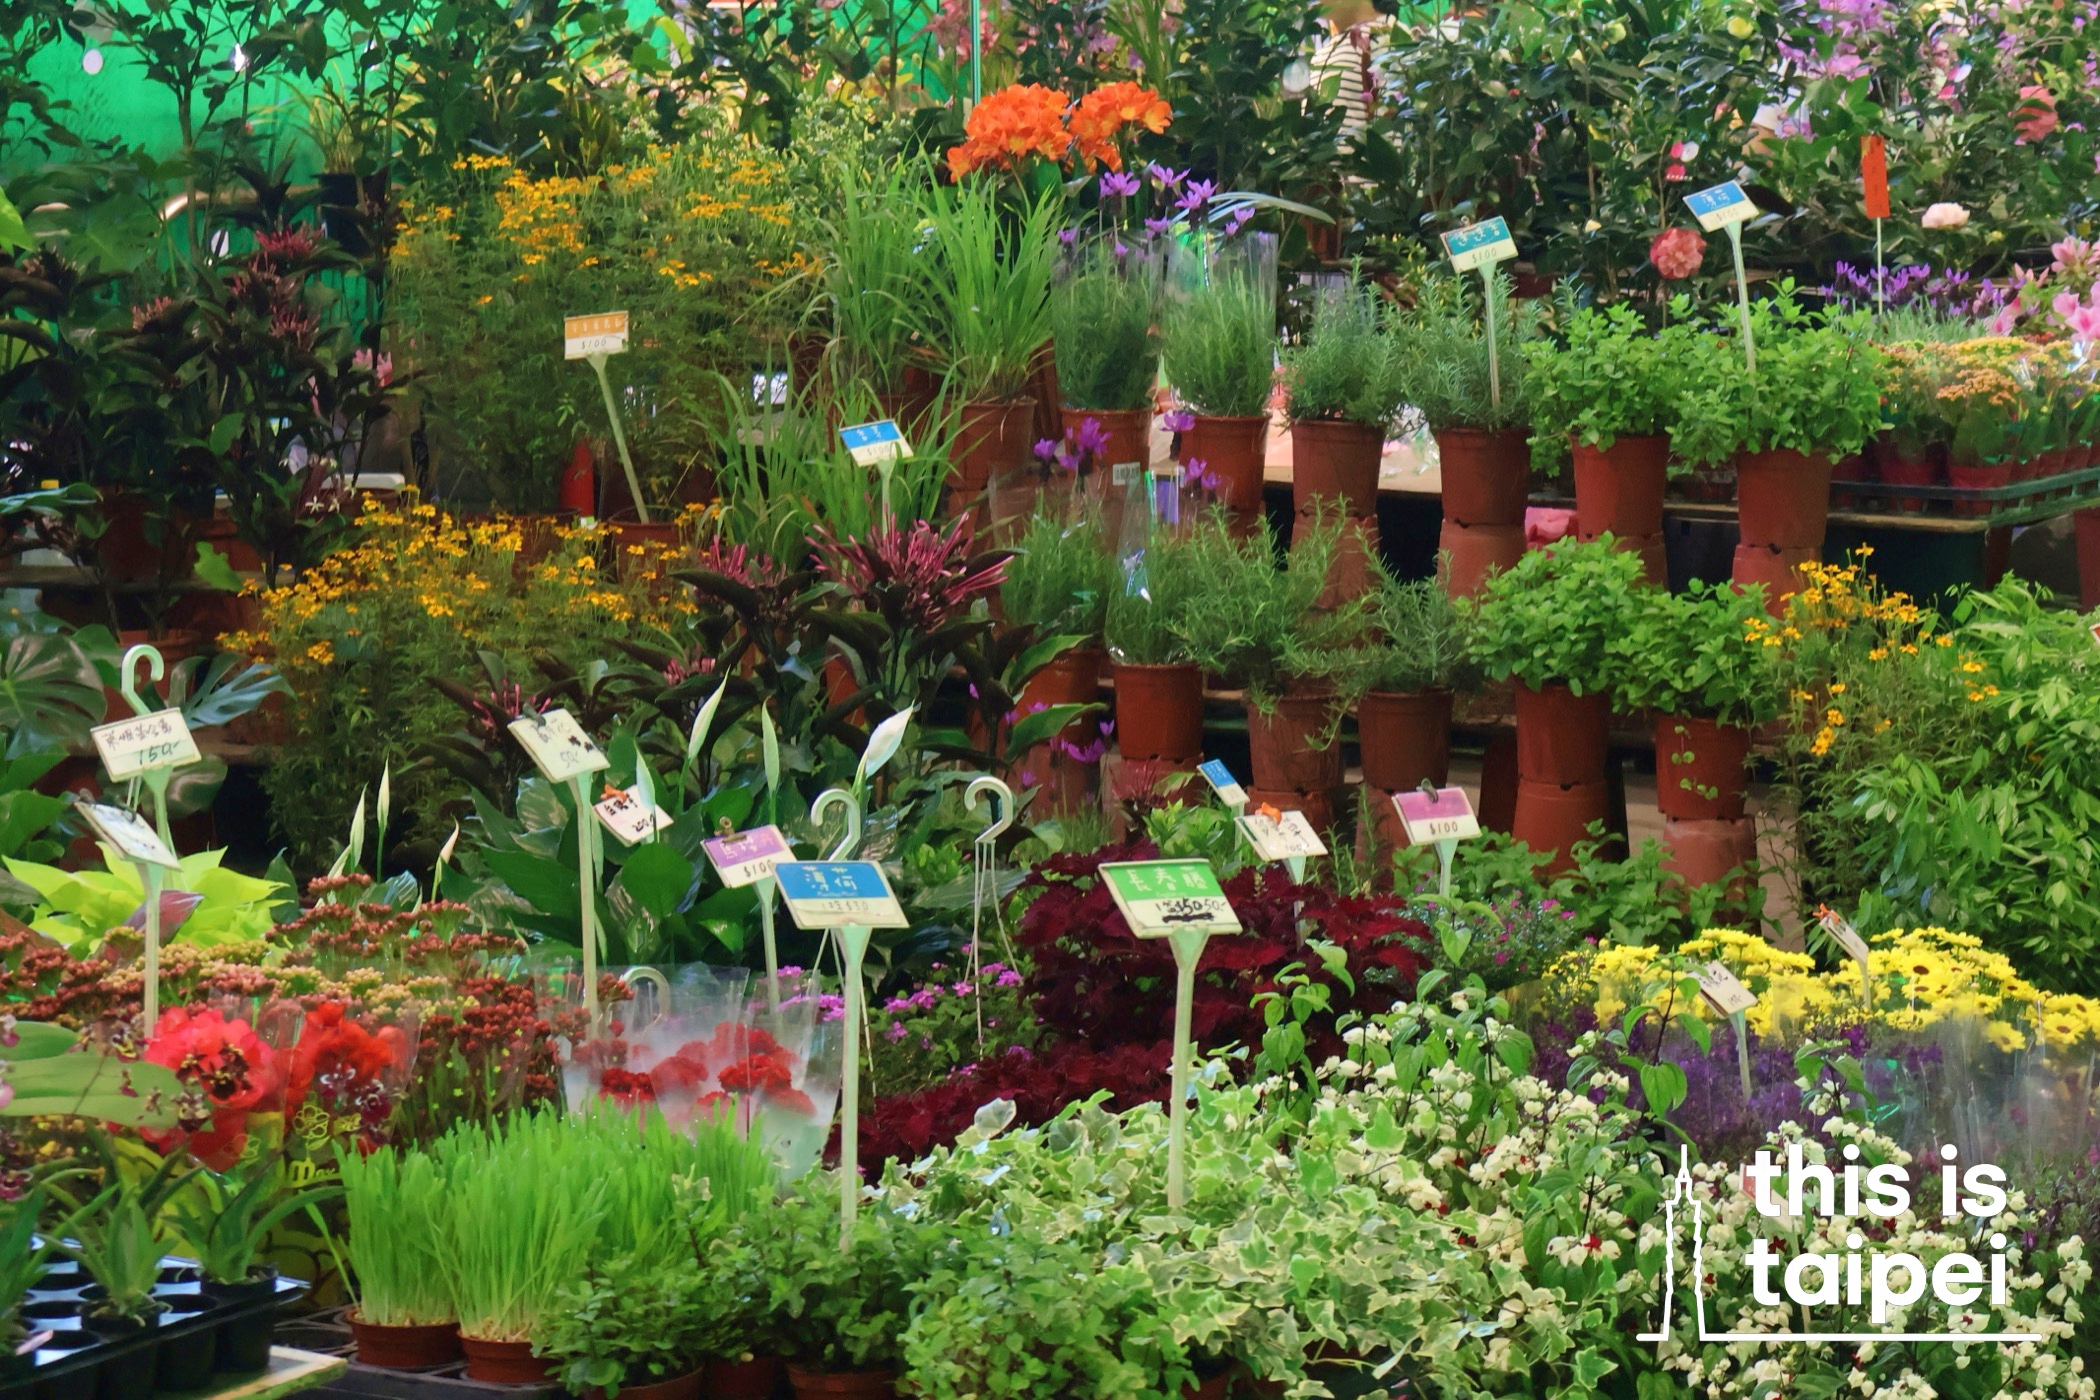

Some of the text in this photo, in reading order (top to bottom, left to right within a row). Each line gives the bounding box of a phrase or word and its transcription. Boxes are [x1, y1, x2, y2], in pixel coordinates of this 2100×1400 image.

[1472, 247, 1497, 264] $100
[582, 338, 607, 350] $100
[1429, 821, 1459, 836] $100
[801, 865, 857, 892] 薄荷
